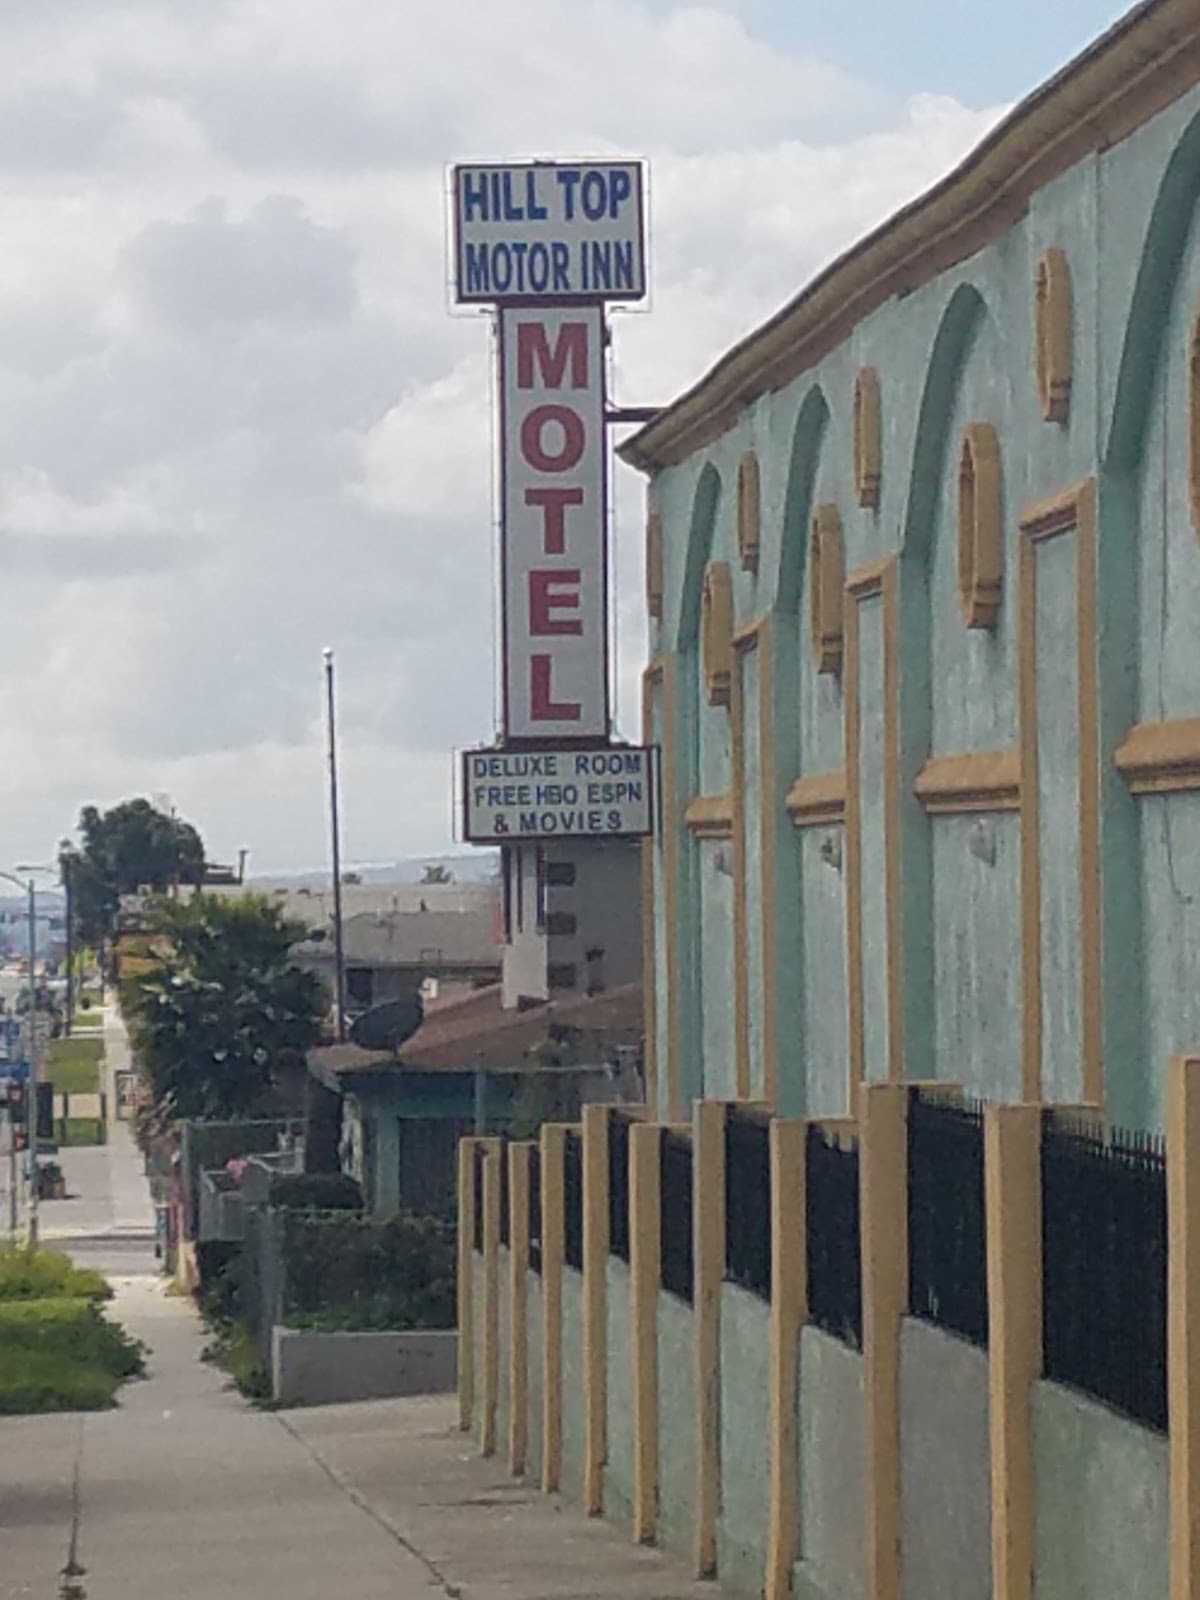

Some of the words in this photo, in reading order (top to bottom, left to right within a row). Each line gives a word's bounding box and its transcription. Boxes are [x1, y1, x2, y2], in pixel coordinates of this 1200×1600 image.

[463, 171, 547, 222] HILL
[556, 170, 631, 221] TOP
[465, 242, 570, 292] MOTOR
[581, 240, 634, 290] INN
[517, 322, 588, 721] MOTEL
[473, 755, 557, 778] DELUXE
[575, 754, 641, 775] ROOM
[473, 785, 530, 807] FREE
[536, 784, 578, 805] HBO
[587, 782, 642, 804] ESPN
[494, 814, 509, 834] &
[519, 811, 622, 832] MOVIES
